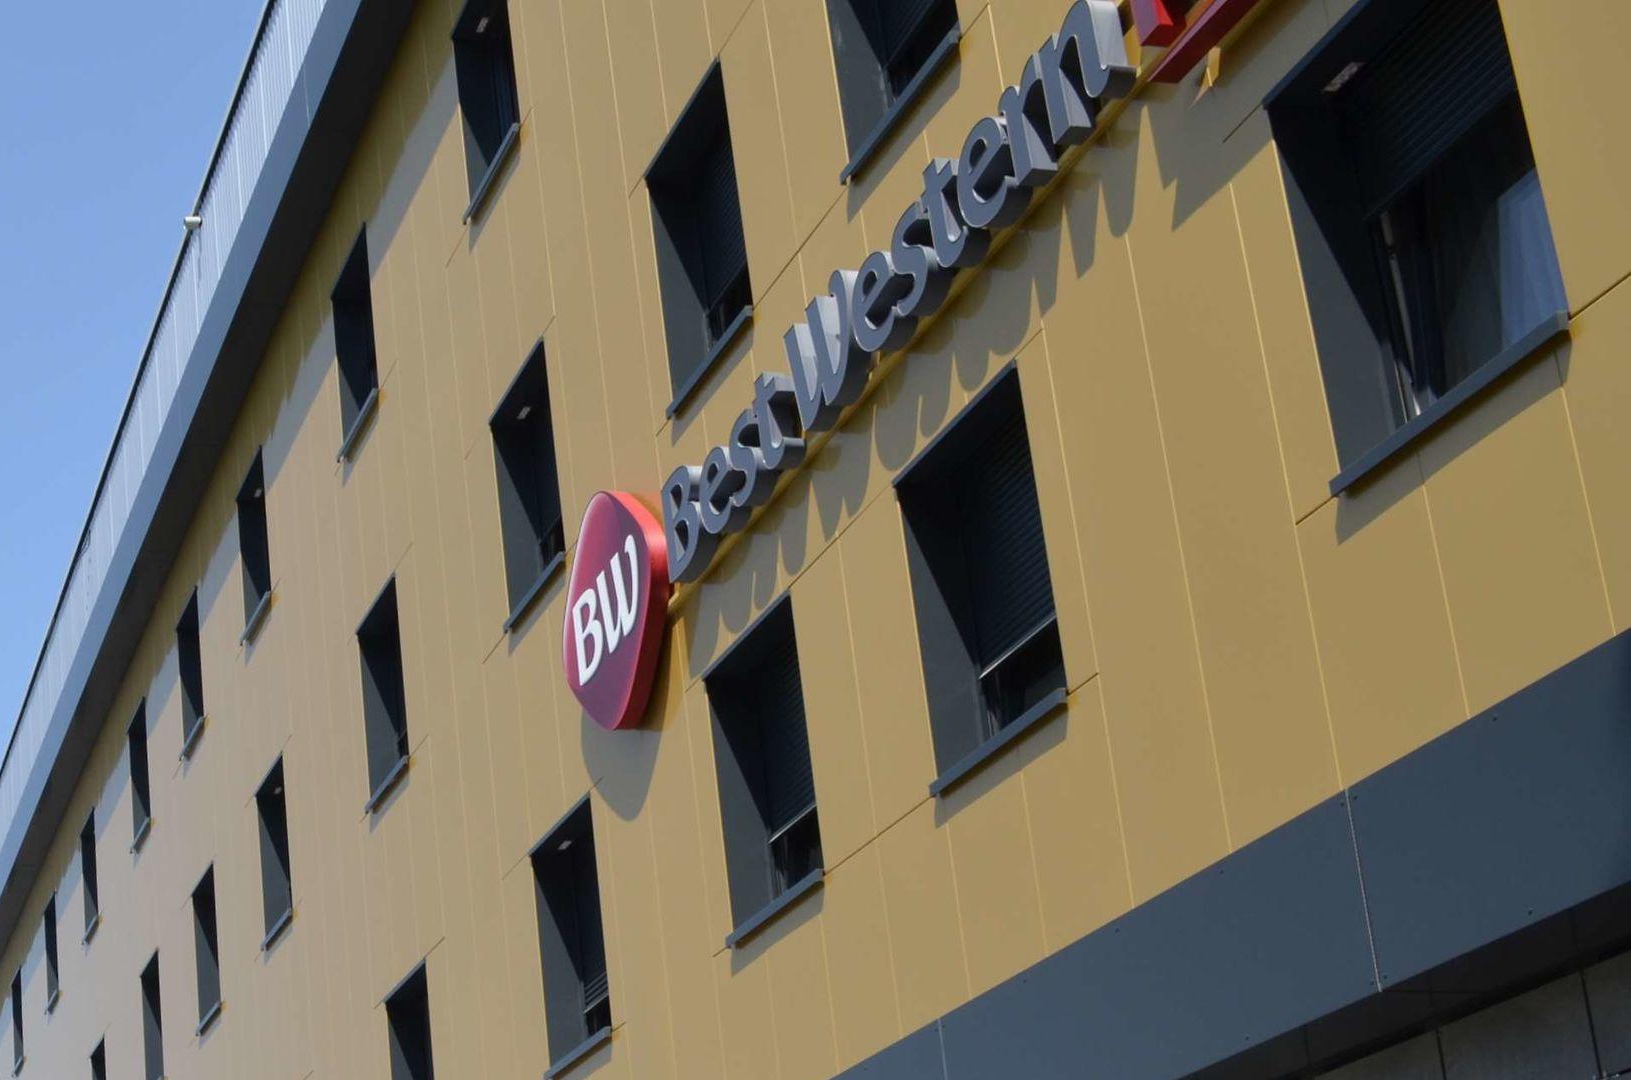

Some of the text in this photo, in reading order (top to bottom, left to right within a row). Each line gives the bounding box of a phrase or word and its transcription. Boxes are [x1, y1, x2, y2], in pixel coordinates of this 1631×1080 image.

[661, 0, 1132, 584] Best Western
[572, 534, 638, 686] BW
